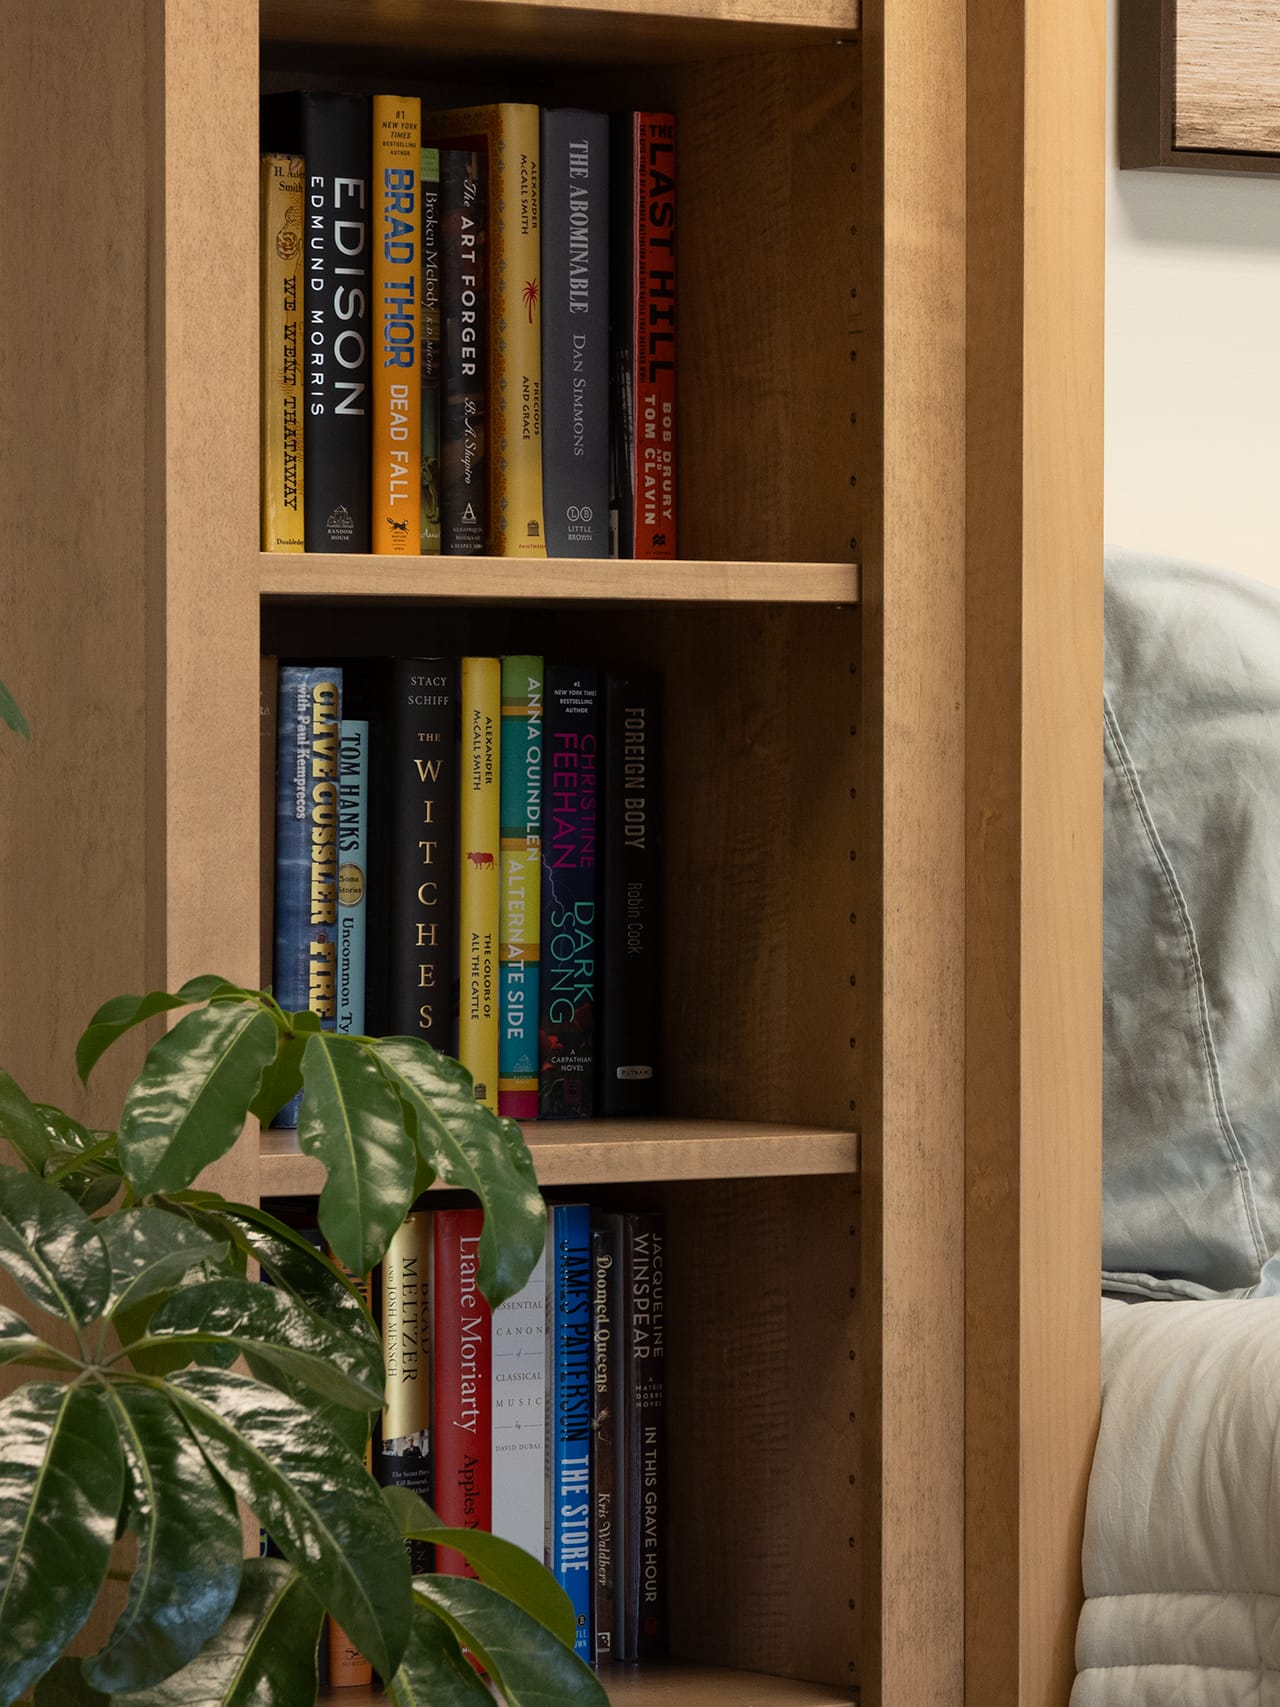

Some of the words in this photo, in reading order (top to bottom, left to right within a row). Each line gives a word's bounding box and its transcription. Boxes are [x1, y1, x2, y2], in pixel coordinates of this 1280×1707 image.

[390, 131, 412, 139] TIMES
[396, 110, 406, 120] #1
[400, 122, 417, 130] YORK
[649, 124, 673, 139] THE
[279, 180, 304, 193] Smith
[520, 153, 529, 196] McCALL
[569, 140, 589, 180] THE
[384, 168, 415, 264] BRAD
[424, 192, 438, 246] Broken
[464, 178, 479, 208] The
[520, 199, 528, 235] SMITH
[649, 142, 674, 256] LAST
[310, 176, 324, 292] EDMUND
[460, 216, 476, 262] ART
[569, 184, 589, 314] ABOMINABLE
[284, 276, 296, 311] WE
[334, 177, 366, 416] EDISON
[421, 250, 439, 310] Melody
[384, 275, 415, 368] THOR
[460, 275, 476, 376] FORGER
[649, 270, 674, 384] HILL
[284, 322, 296, 386] WENT
[310, 310, 324, 416] MORRIS
[573, 334, 586, 372] DAN
[390, 384, 409, 440] DEAD
[522, 376, 530, 401] AND
[522, 404, 530, 441] GRACE
[572, 378, 586, 456] SIMMONS
[644, 394, 656, 439] TOM
[662, 402, 672, 442] BOB
[284, 396, 297, 511] THATAWAY
[390, 450, 409, 506] FALL
[460, 440, 477, 486] Shapiro
[644, 447, 656, 525] CLAVIN
[662, 450, 672, 520] DRURY
[296, 682, 311, 712] with
[407, 694, 450, 706] SCHIFF
[410, 676, 448, 687] STACY
[527, 677, 542, 740] ANNA
[296, 715, 311, 746] Paul
[312, 682, 339, 778] CLIVE
[340, 732, 361, 776] TOM
[418, 732, 441, 743] THE
[474, 710, 482, 751] McCALL
[624, 707, 646, 790] FOREIGN
[293, 748, 310, 820] Kemprecos
[525, 746, 541, 862] QUINDLEN
[551, 732, 579, 869] FEEHAN
[580, 733, 597, 868] CHRISTINE
[340, 784, 360, 851] HANKS
[624, 798, 646, 850] BODY
[310, 780, 338, 924] CUSSLER
[414, 758, 443, 1029] WITCHES
[626, 881, 643, 918] Robin
[484, 934, 492, 954] THE
[506, 860, 525, 984] ALTERNATE
[627, 922, 644, 955] Cook
[308, 941, 336, 1018] FIRE
[342, 917, 354, 1007] Uncommon
[549, 910, 576, 1024] SONG
[574, 901, 596, 1003] DARK
[471, 980, 479, 1020] CATTLE
[484, 1006, 491, 1019] OF
[506, 991, 524, 1040] SIDE
[551, 1056, 592, 1064] CARPATHIAN
[560, 1064, 584, 1072] NOVEL
[460, 1236, 480, 1309] Liane
[560, 1240, 589, 1314] JAMES
[596, 1254, 613, 1324] Doomed
[632, 1233, 650, 1360] WINSPEAR
[652, 1233, 664, 1358] JACQUELINE
[388, 1284, 398, 1317] JOSH
[402, 1257, 418, 1383] MELTZER
[388, 1322, 398, 1377] MENSCH
[496, 1326, 543, 1336] CANON
[453, 1316, 482, 1435] Moriarty
[496, 1372, 542, 1382] CLASSICAL
[560, 1323, 590, 1442] PATTERSON
[594, 1328, 609, 1393] Queens
[496, 1398, 542, 1408] MUSIC
[495, 1444, 517, 1452] DAVID
[520, 1443, 542, 1451] DUBAL
[644, 1426, 657, 1445] IN
[458, 1455, 481, 1515] Apples
[561, 1454, 590, 1497] THE
[644, 1449, 657, 1488] THIS
[598, 1493, 611, 1518] Kris
[644, 1492, 657, 1548] GRAVE
[561, 1503, 590, 1574] STORE
[598, 1520, 611, 1587] Waldherr
[644, 1553, 657, 1602] HOUR
